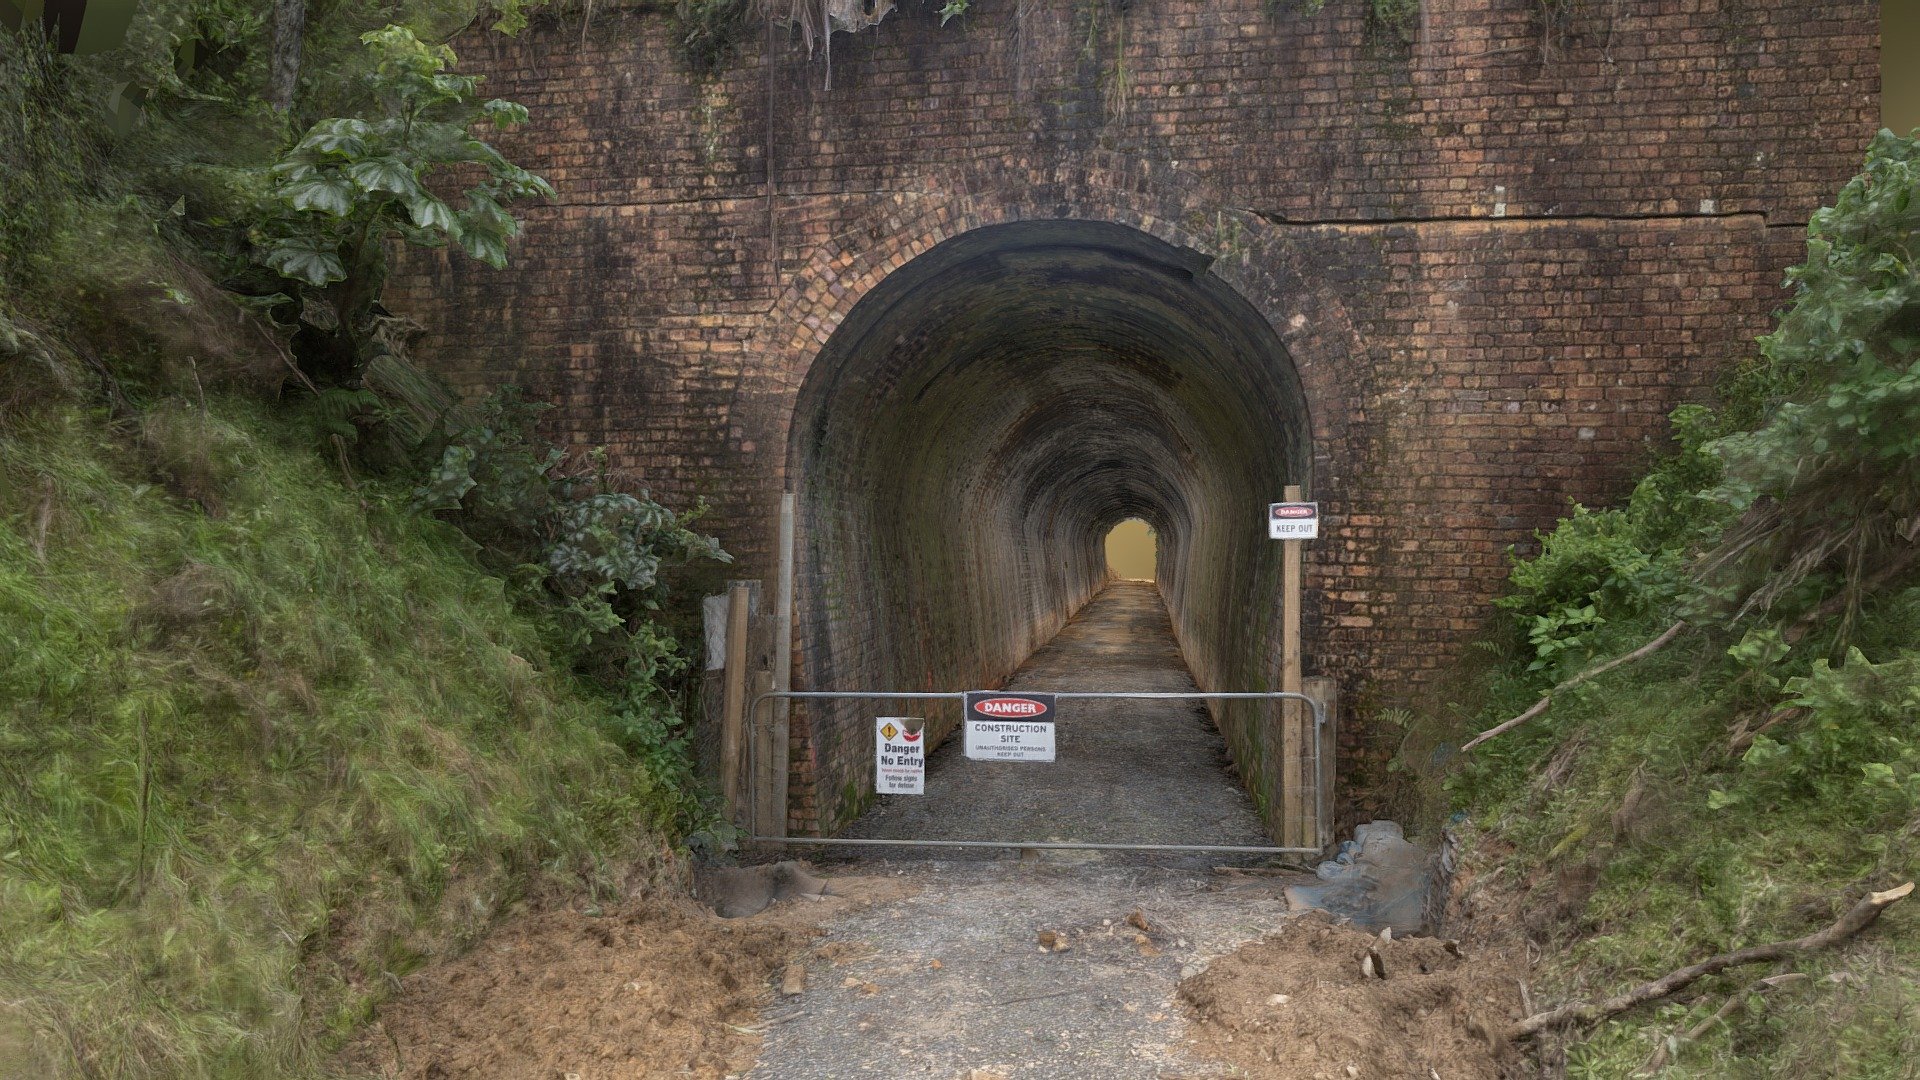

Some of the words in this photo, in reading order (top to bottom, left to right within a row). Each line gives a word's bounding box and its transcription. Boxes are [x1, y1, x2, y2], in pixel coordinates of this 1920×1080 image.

[1276, 524, 1295, 532] KEEP
[1299, 524, 1313, 532] OUT
[984, 702, 1036, 713] DANGER
[975, 724, 1047, 733] CONSTRUCTION
[1001, 735, 1021, 743] SITE
[885, 743, 920, 755] Danger
[881, 756, 894, 765] No
[897, 756, 923, 767] Entry
